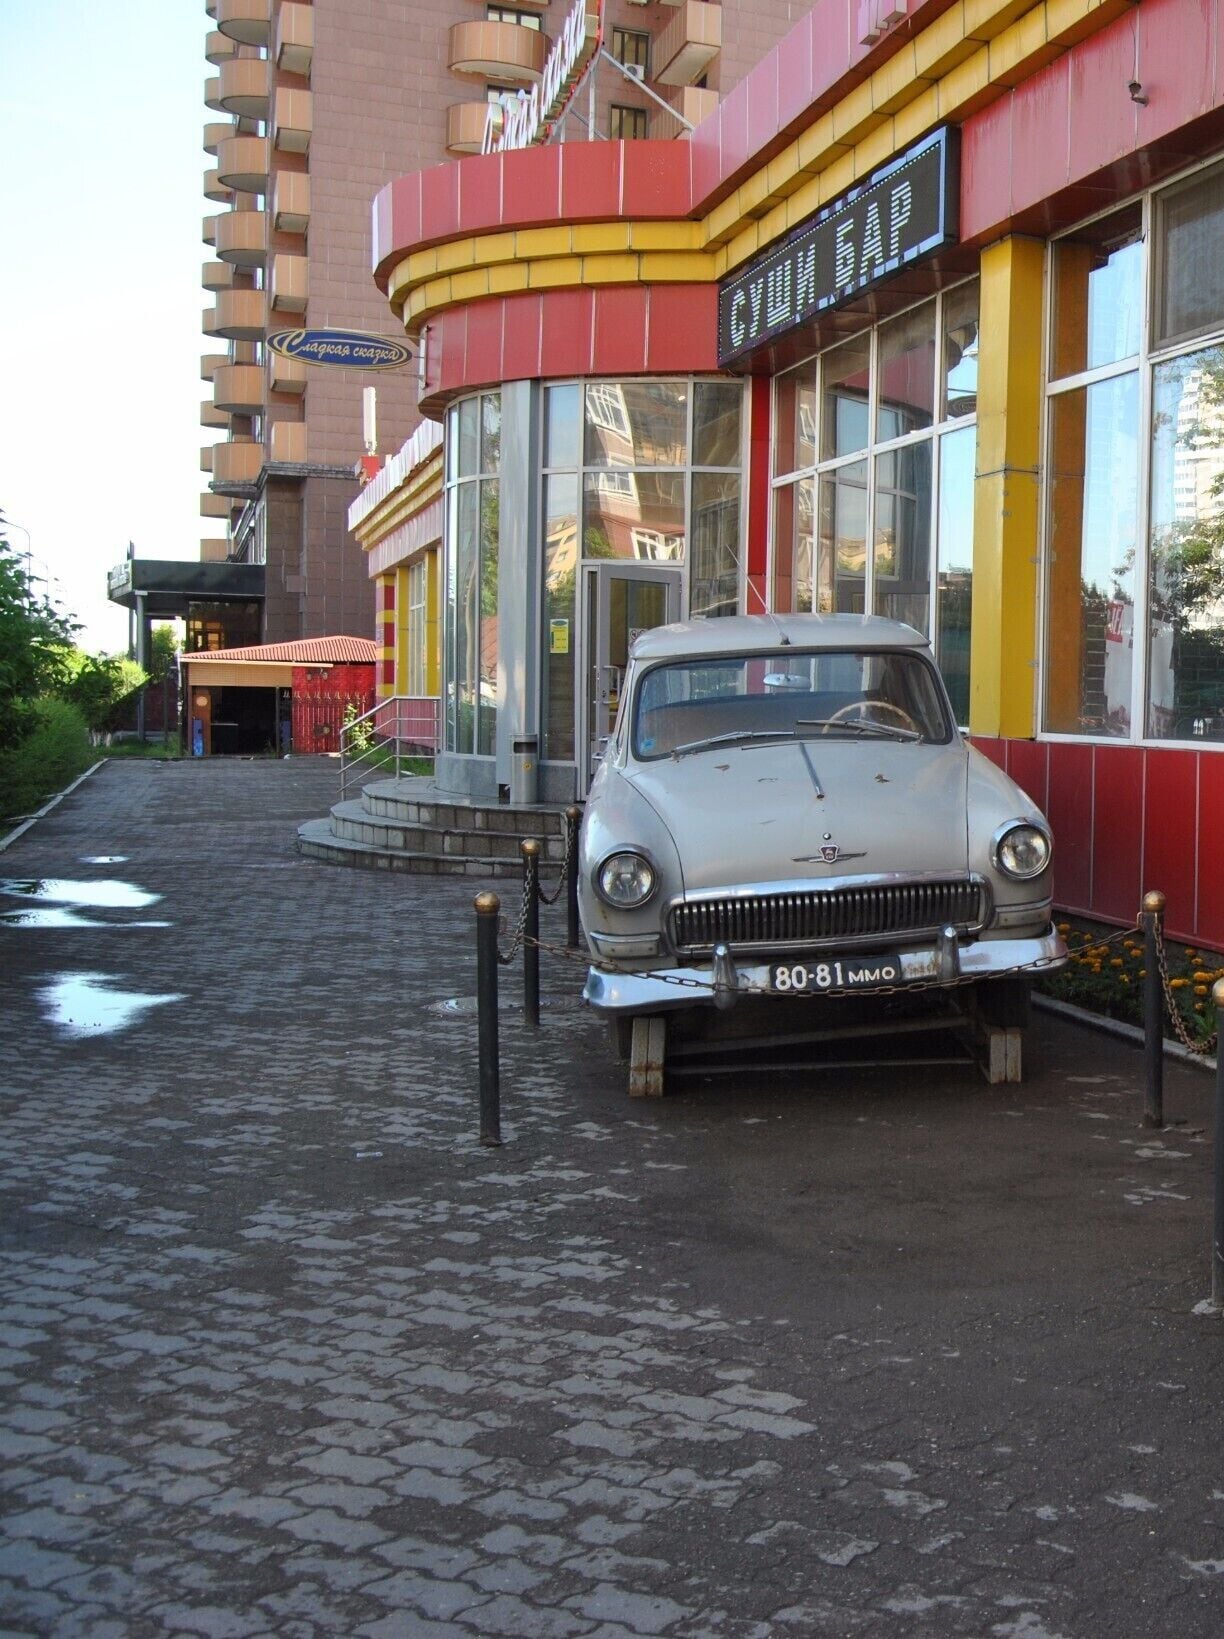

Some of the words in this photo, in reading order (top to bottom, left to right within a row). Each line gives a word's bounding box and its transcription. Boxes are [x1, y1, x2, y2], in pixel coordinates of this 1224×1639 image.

[730, 243, 816, 348] СУШИ
[835, 180, 912, 289] БАР
[281, 329, 351, 359] Сладкая
[353, 346, 399, 365] сказка
[775, 962, 844, 991] 80-81
[848, 966, 896, 984] ММО
